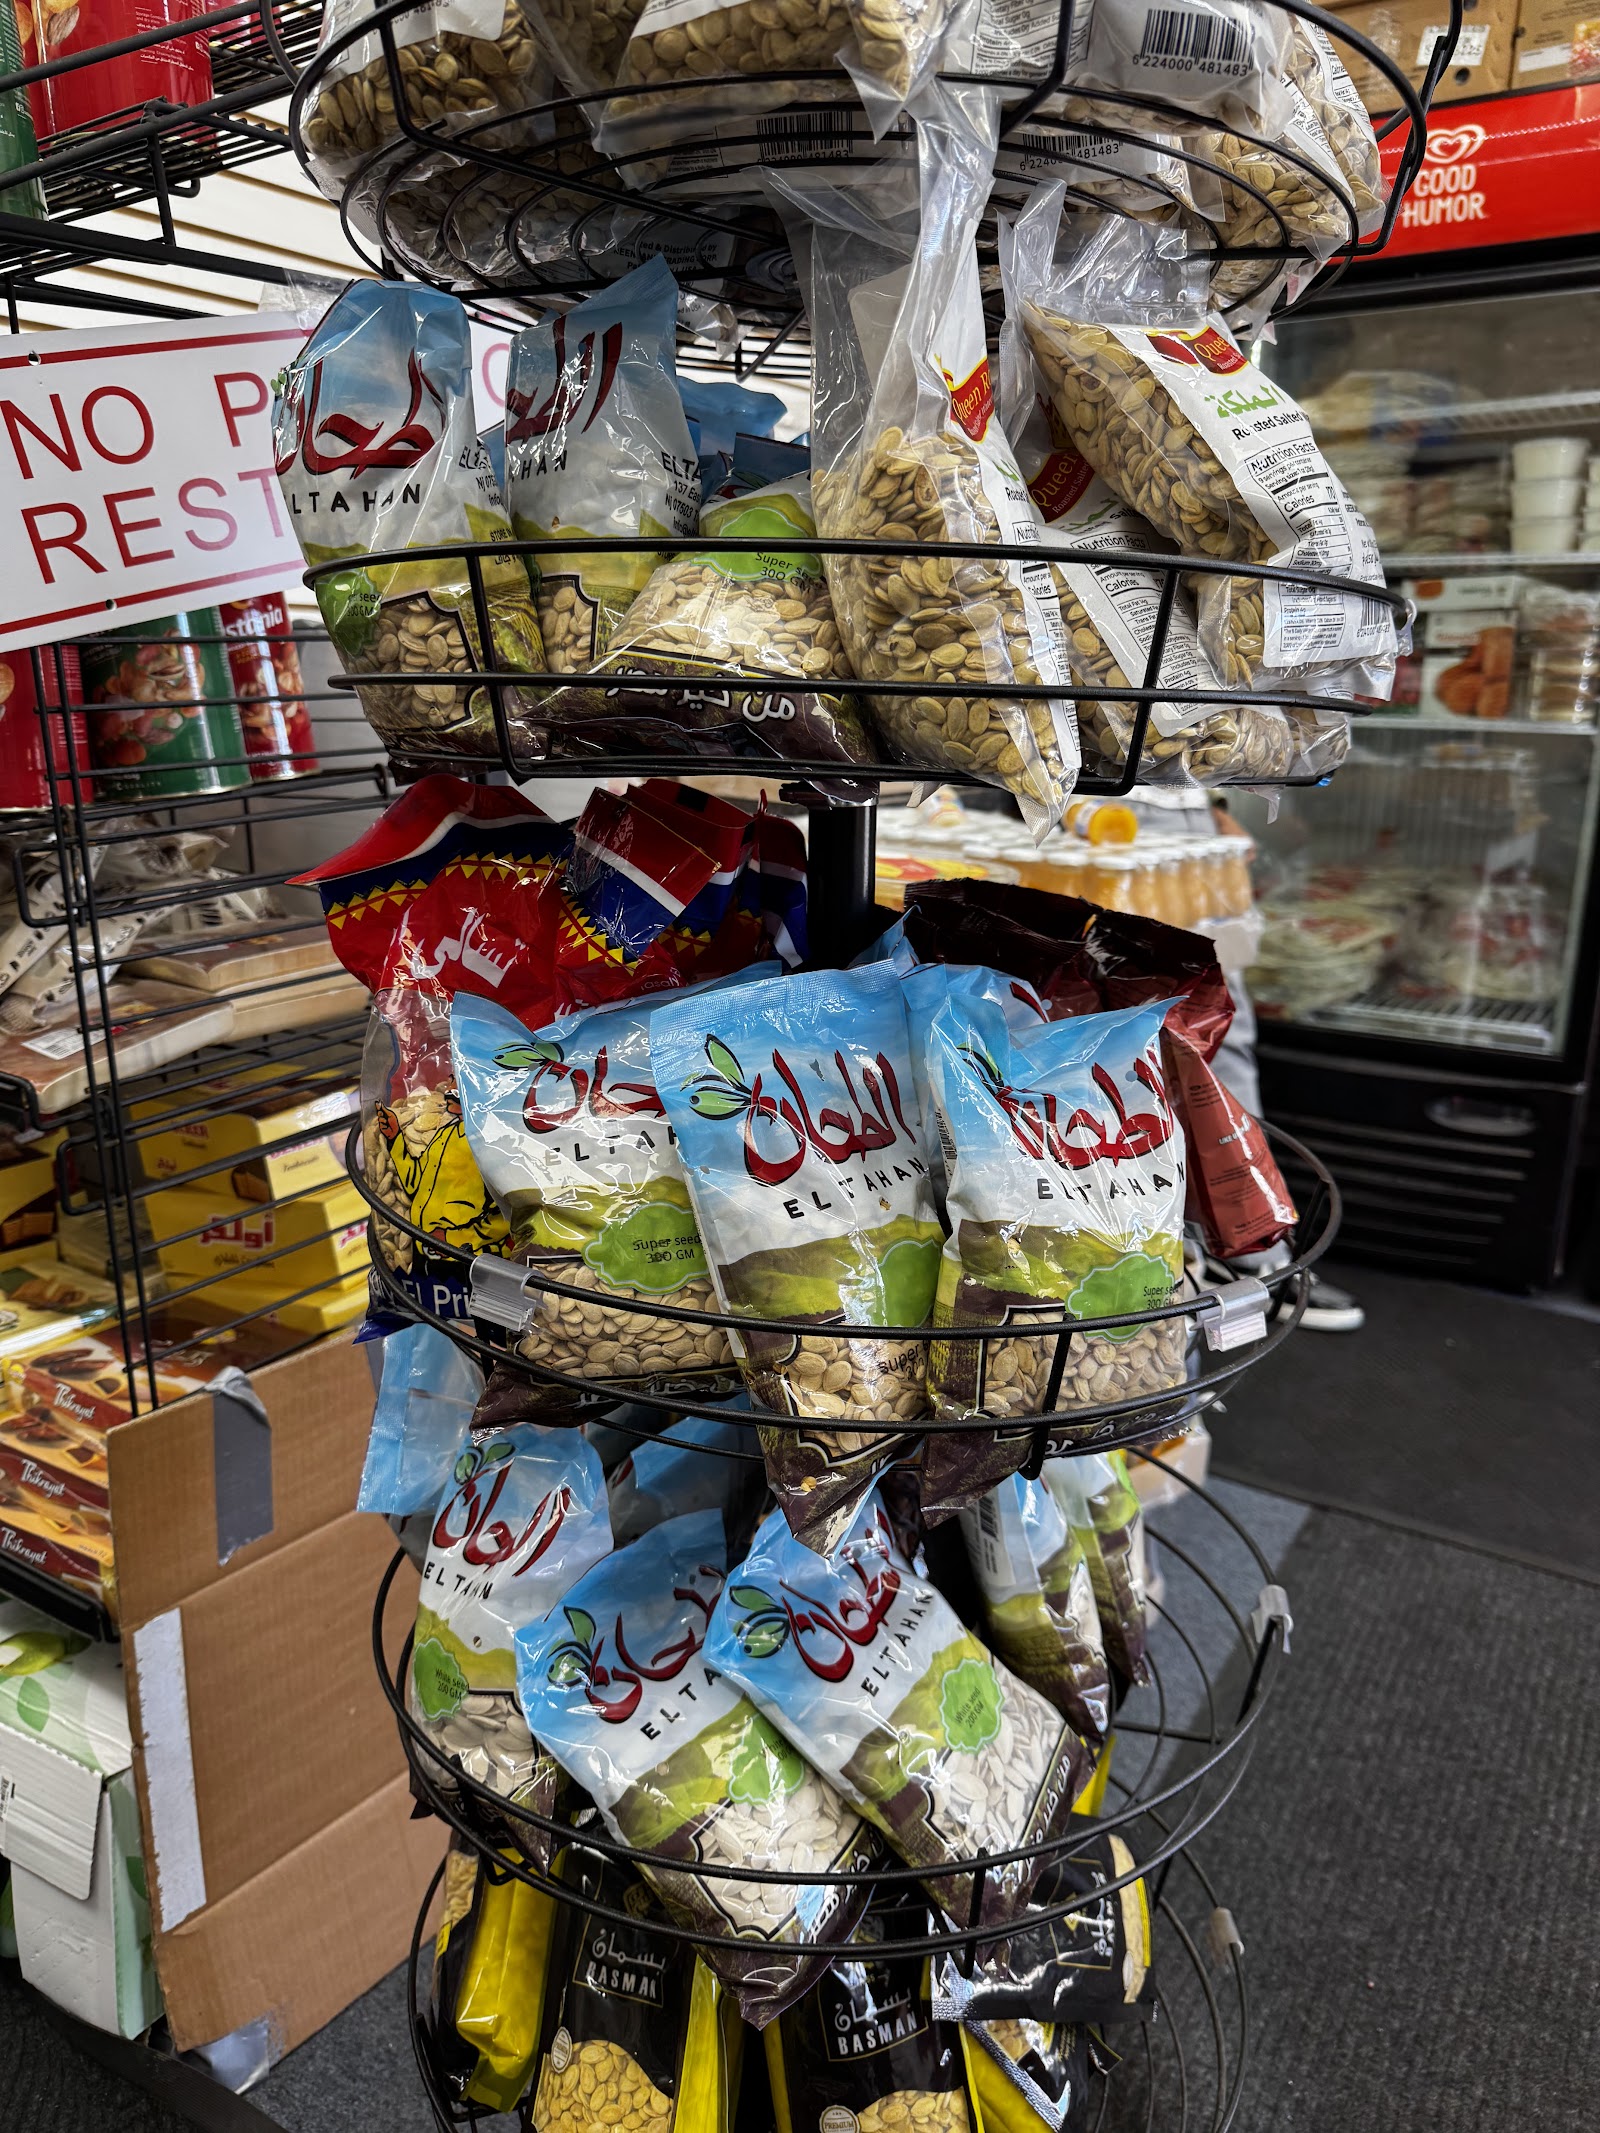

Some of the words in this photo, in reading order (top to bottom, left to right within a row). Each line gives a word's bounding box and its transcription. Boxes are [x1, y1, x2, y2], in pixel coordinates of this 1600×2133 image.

[1132, 53, 1140, 65] 6
[1142, 55, 1193, 72] 224000
[1199, 61, 1249, 77] 481483
[1414, 164, 1476, 198] GOOD
[1402, 192, 1485, 228] HUMOR
[953, 386, 982, 426] Queen
[0, 385, 155, 480] NO
[1251, 446, 1297, 475] Nutrition
[1293, 442, 1316, 455] Facts
[1263, 465, 1288, 482] servings
[1265, 476, 1288, 490] Serving
[674, 480, 688, 495] 137
[672, 497, 693, 520] 07503
[1284, 494, 1315, 513] Calories
[755, 552, 793, 569] Super
[1105, 577, 1140, 593] Calories
[1164, 673, 1184, 685] Protein
[675, 1248, 695, 1260] GM
[640, 1667, 722, 1740] ELTA
[837, 2010, 919, 2056] BASMAN
